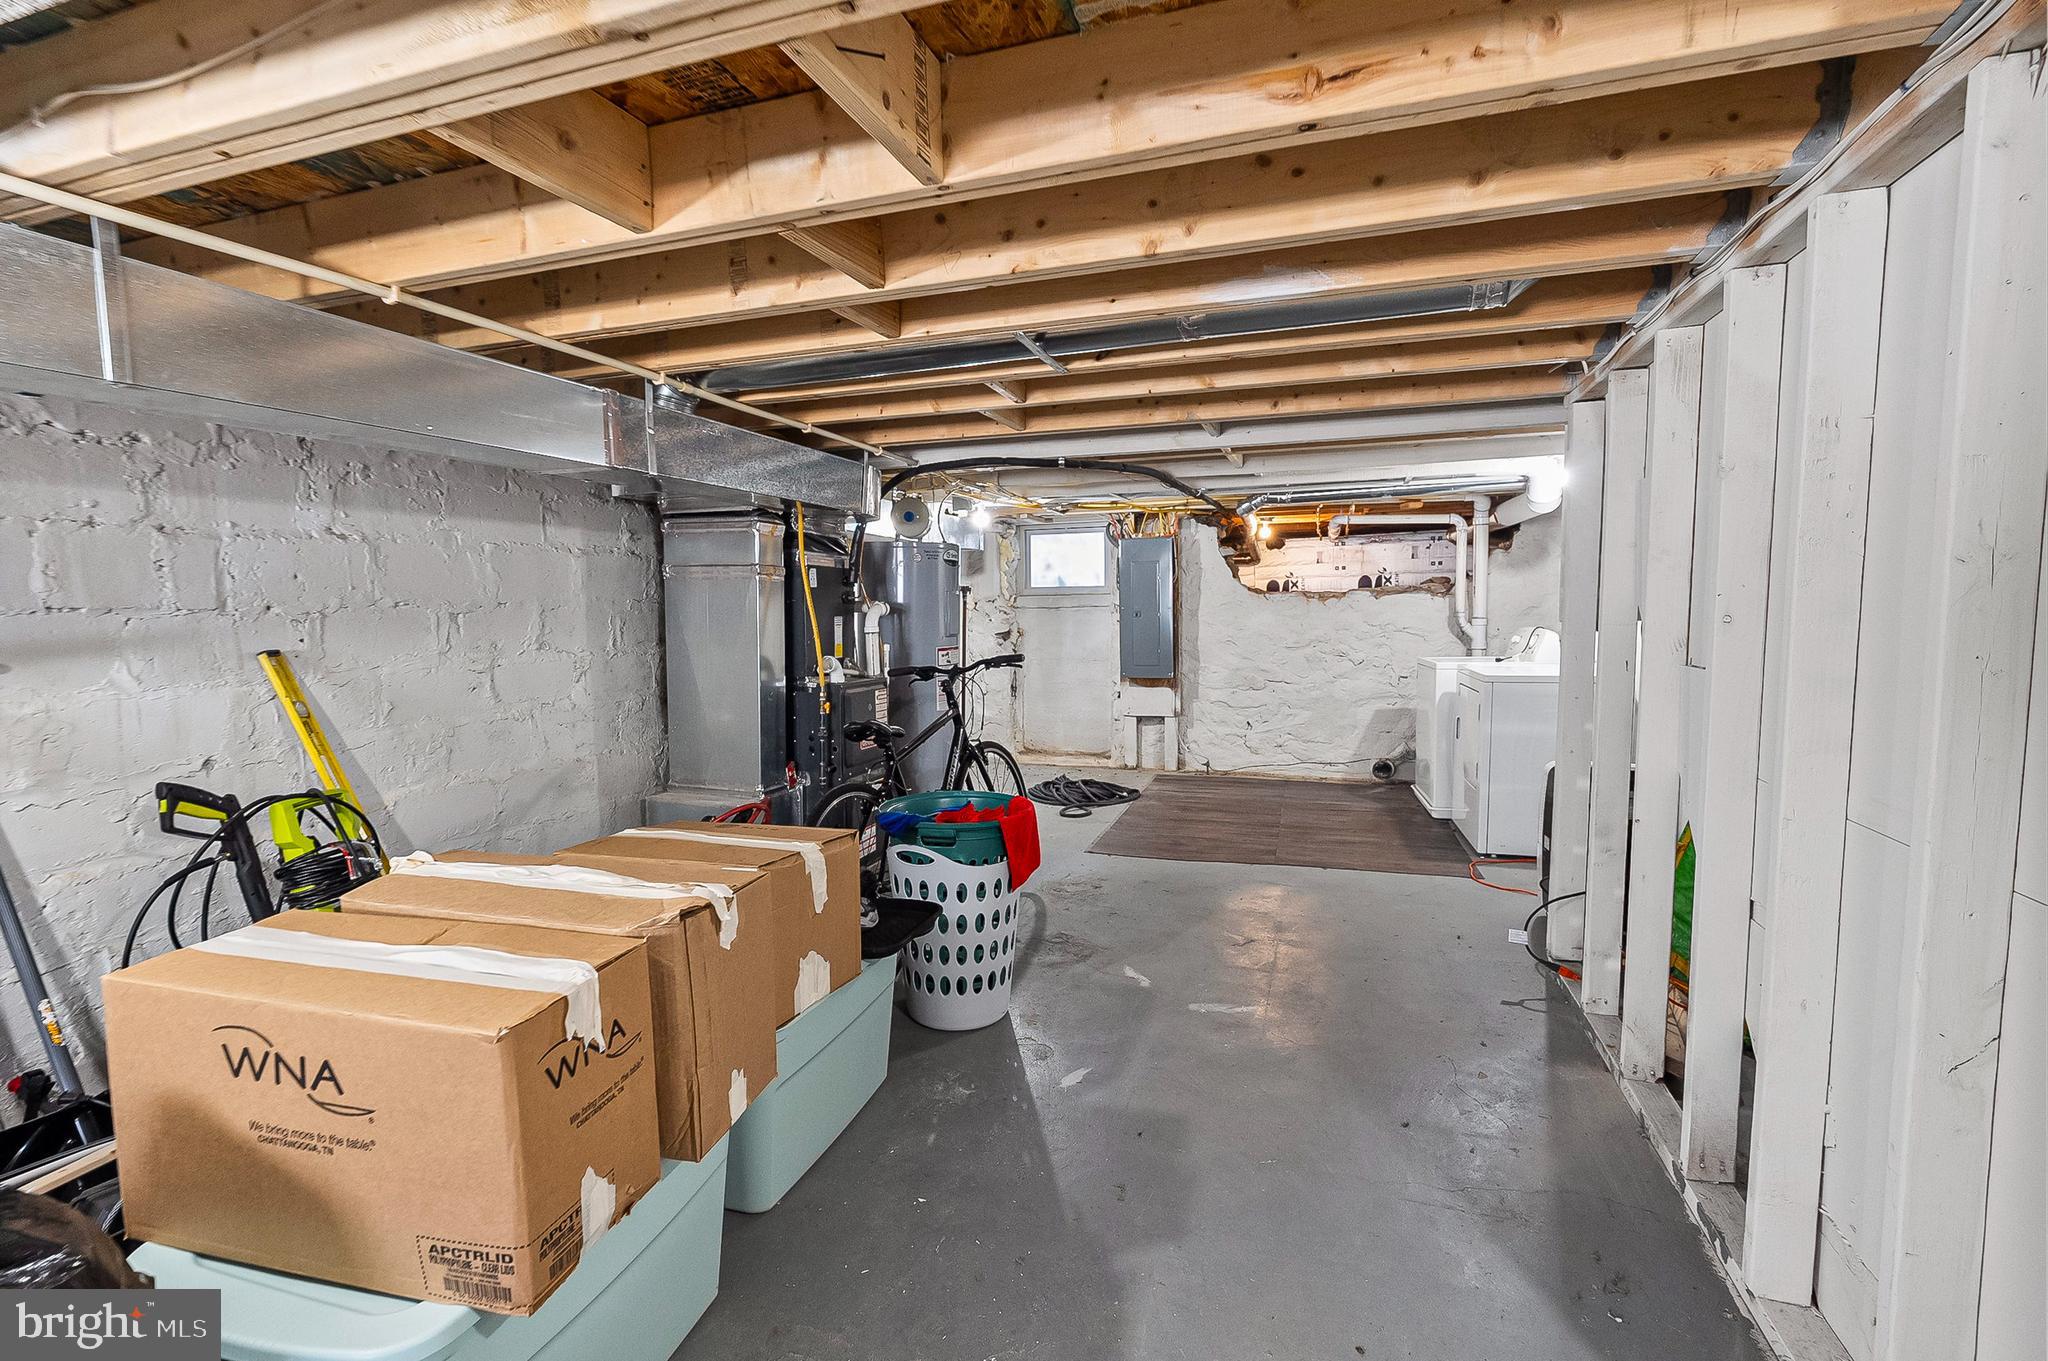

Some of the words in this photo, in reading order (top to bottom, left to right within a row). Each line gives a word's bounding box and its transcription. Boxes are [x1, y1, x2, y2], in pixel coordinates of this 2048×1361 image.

[221, 1043, 345, 1096] WNA
[249, 1119, 264, 1133] We
[265, 1122, 289, 1141] bring
[290, 1130, 315, 1141] more
[316, 1132, 327, 1144] to
[328, 1134, 344, 1147] the
[428, 1244, 514, 1264] APCTRLID
